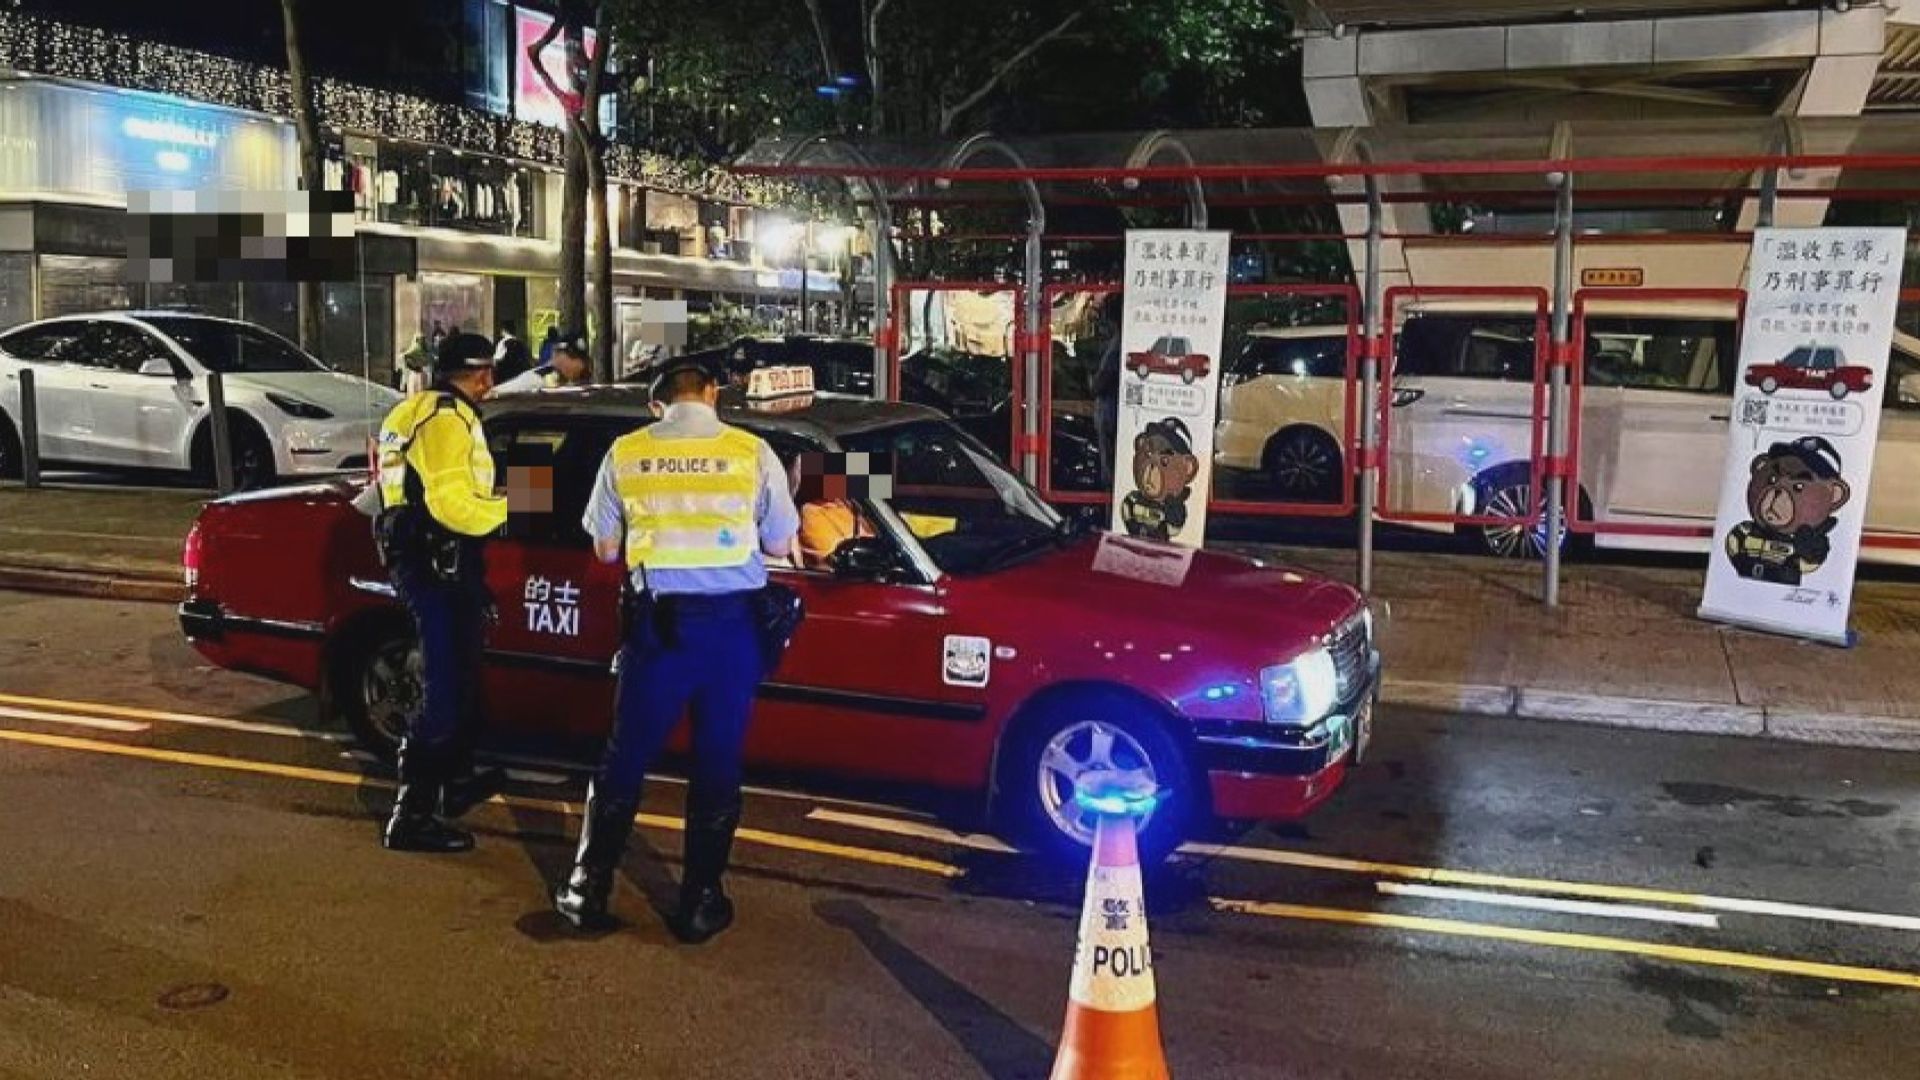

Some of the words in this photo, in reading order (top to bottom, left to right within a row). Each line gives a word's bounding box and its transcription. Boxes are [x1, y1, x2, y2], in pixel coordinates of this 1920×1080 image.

[1761, 269, 1883, 294] 乃刑事罪行
[657, 458, 710, 473] POLICE
[524, 574, 581, 604] 的士
[523, 602, 581, 636] TAXI
